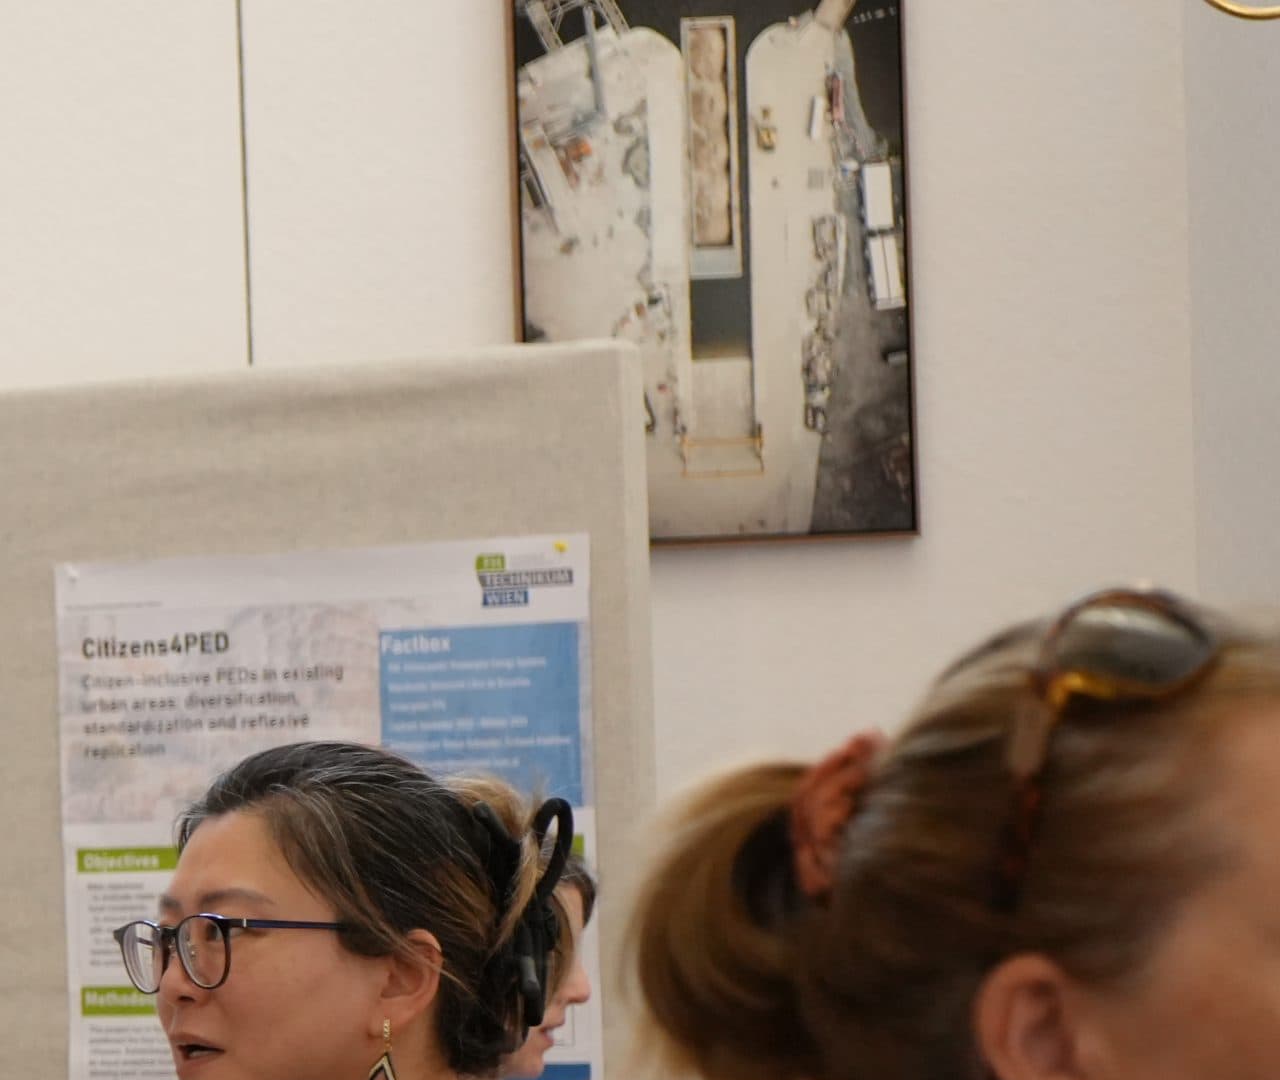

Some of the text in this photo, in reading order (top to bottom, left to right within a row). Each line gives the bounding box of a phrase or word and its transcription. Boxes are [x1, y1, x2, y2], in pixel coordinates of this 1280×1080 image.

[485, 569, 572, 587] TECHNIKUM
[486, 588, 526, 606] WIEN
[81, 631, 230, 659] Citizens4PED
[380, 634, 451, 655] Factbox
[282, 662, 344, 682] existing
[208, 714, 237, 730] and
[241, 712, 310, 729] reflexive
